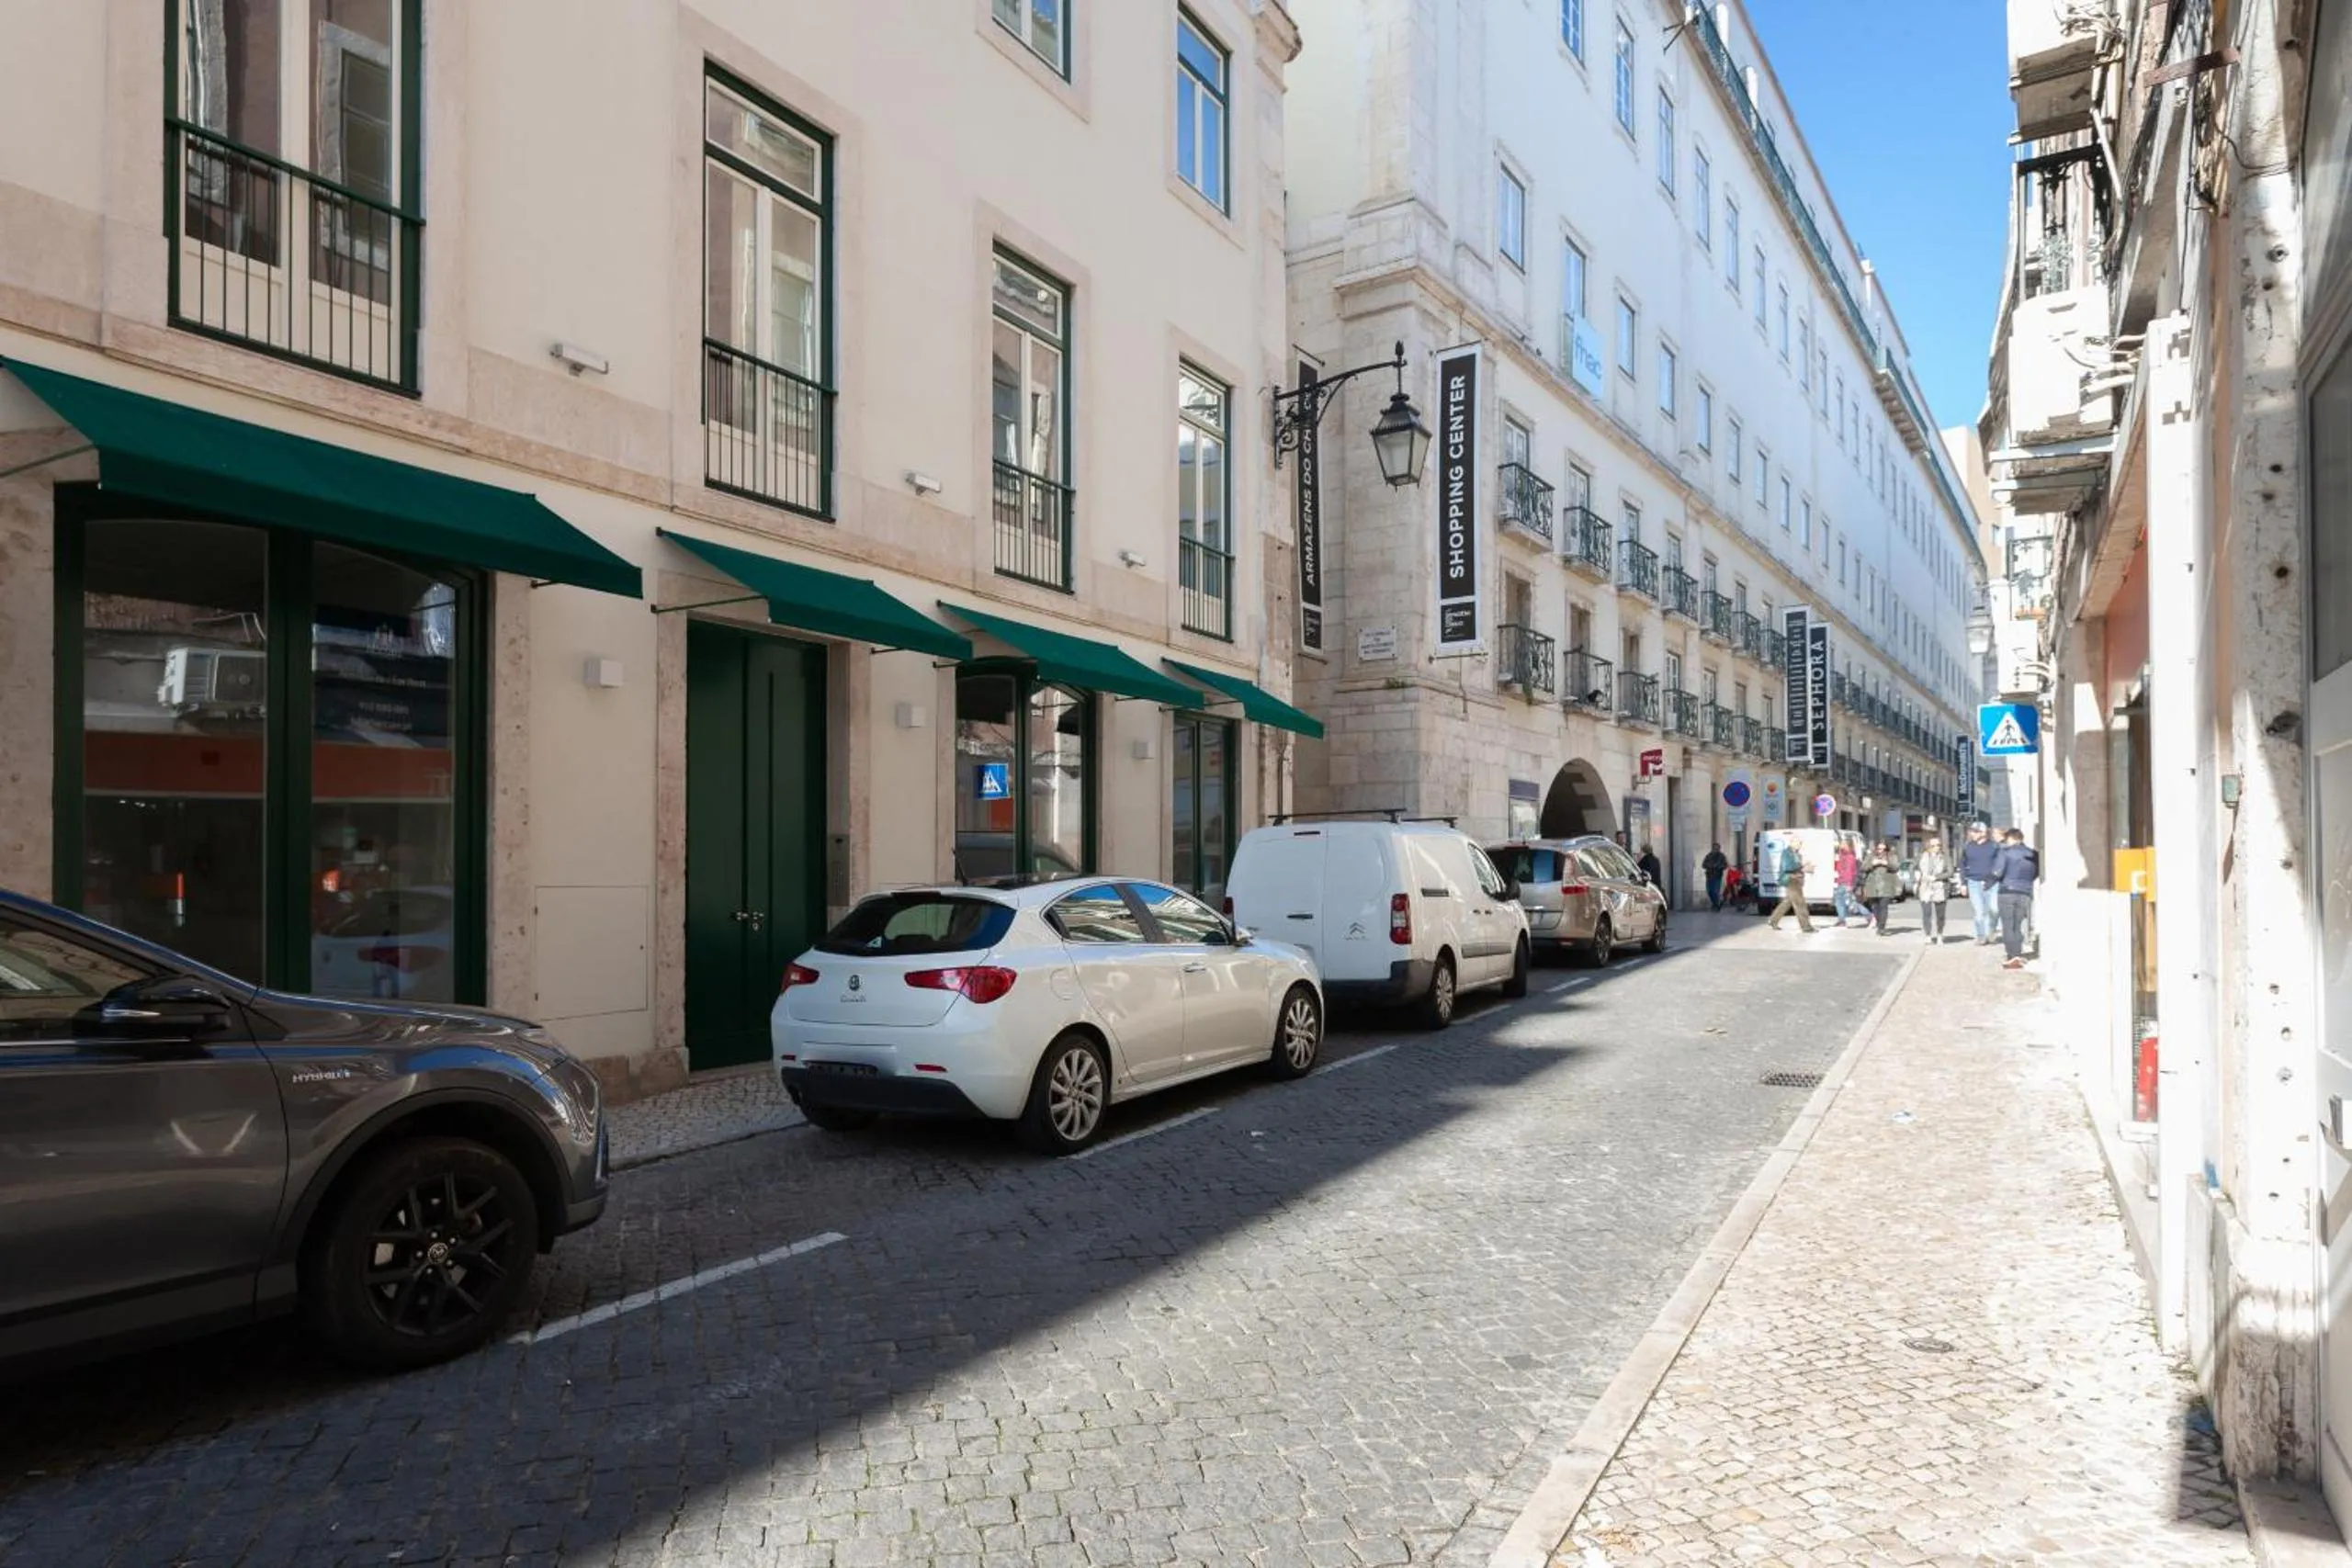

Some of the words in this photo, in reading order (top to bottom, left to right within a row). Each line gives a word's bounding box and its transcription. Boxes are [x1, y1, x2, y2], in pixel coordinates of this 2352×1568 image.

[1450, 375, 1465, 459] CENTER
[1303, 457, 1312, 486] DO
[1303, 488, 1316, 587] ARMAZENS
[1450, 465, 1464, 579] SHOPPING
[1812, 640, 1825, 730] SEPHORA
